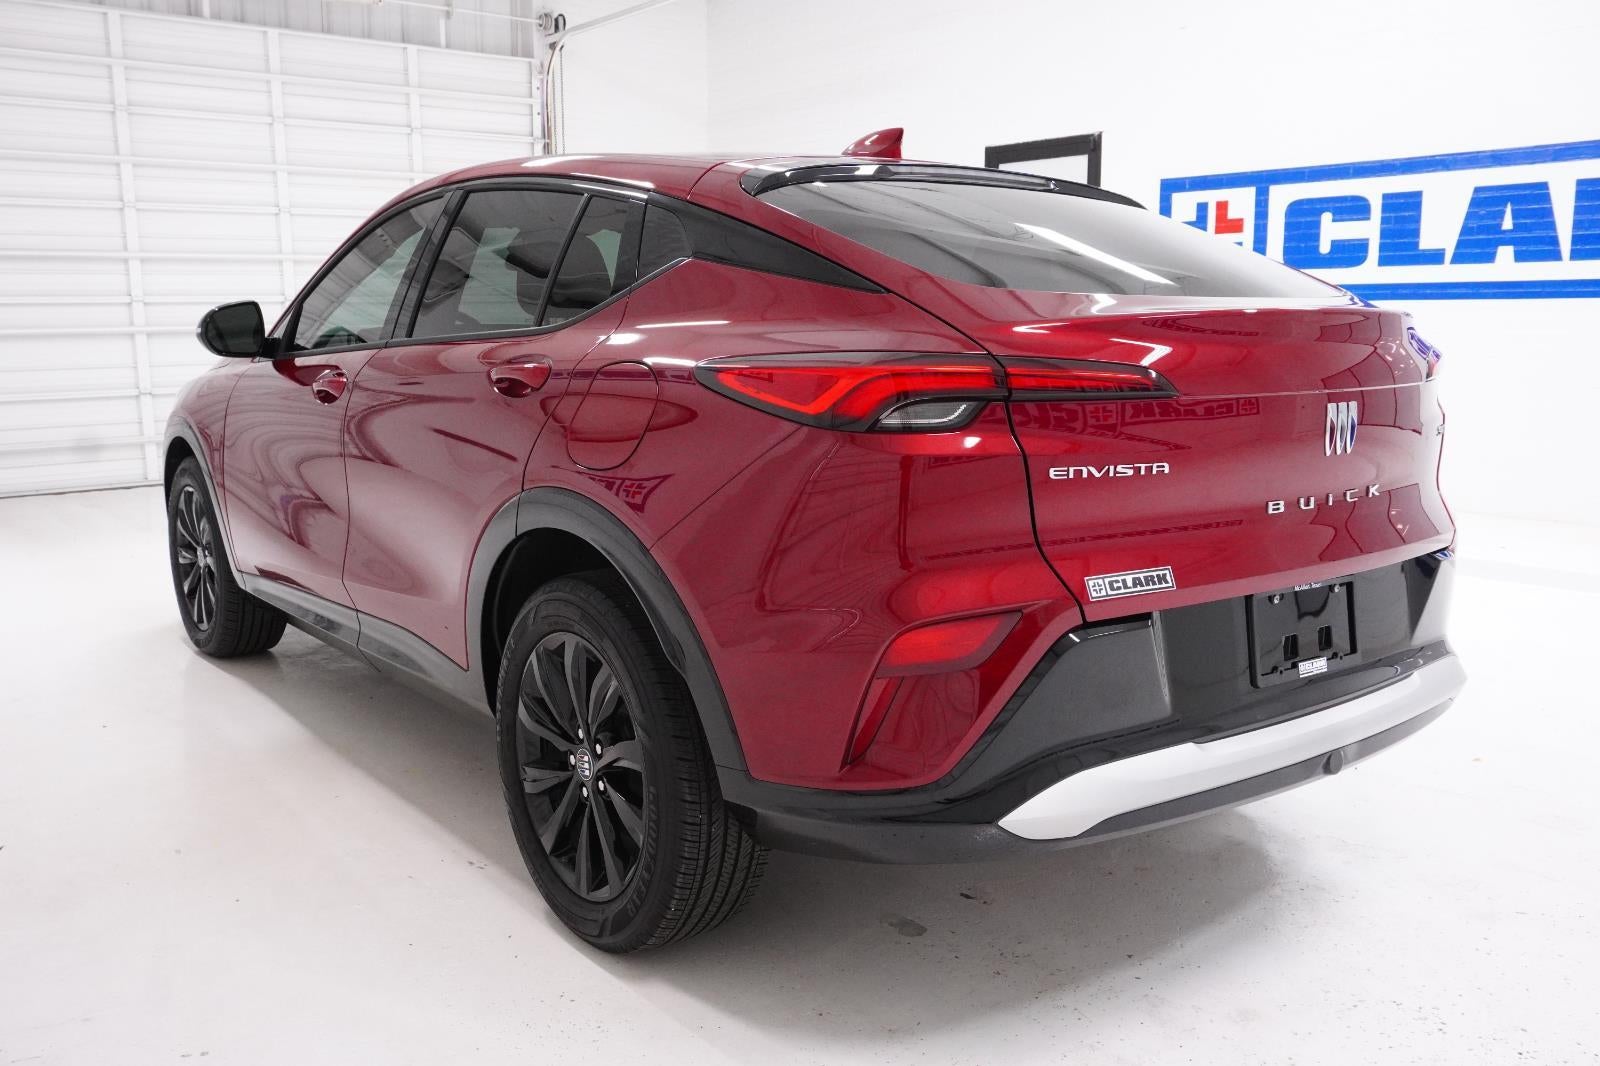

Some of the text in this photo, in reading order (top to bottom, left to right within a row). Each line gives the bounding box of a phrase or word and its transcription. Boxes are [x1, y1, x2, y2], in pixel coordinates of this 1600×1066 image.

[1049, 462, 1169, 479] ENVISTA
[1267, 484, 1380, 514] BUICK
[1107, 573, 1170, 591] CLARK
